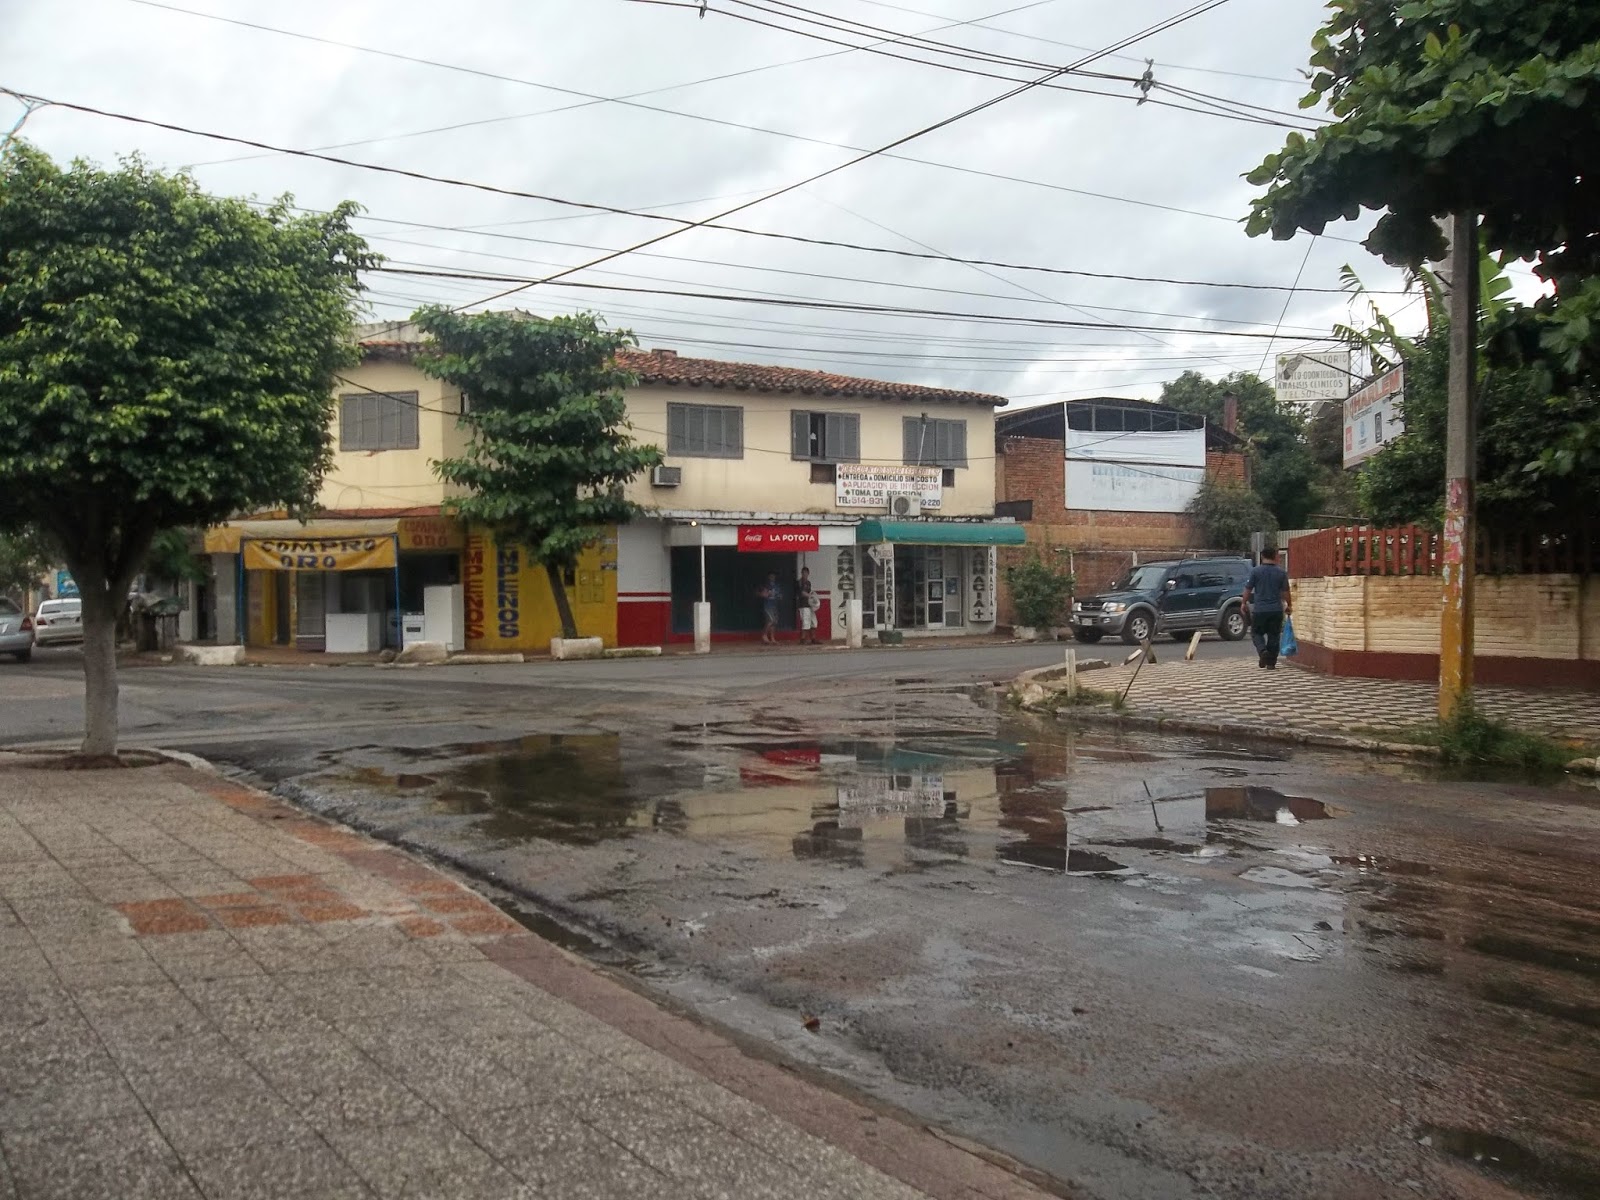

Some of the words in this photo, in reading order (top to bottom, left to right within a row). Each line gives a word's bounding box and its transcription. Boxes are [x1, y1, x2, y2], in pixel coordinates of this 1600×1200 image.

[874, 474, 904, 482] DOMICILIO
[905, 475, 915, 483] SIN
[847, 481, 888, 490] APLICACION
[889, 482, 898, 490] DE
[900, 482, 939, 491] INYECCION
[851, 489, 871, 497] TOMA
[873, 489, 884, 497] DE
[769, 534, 781, 542] LA
[782, 534, 816, 542] POTOTA
[261, 538, 376, 552] COMPRO
[280, 555, 337, 568] ORO
[885, 559, 893, 613] FARMACIA
